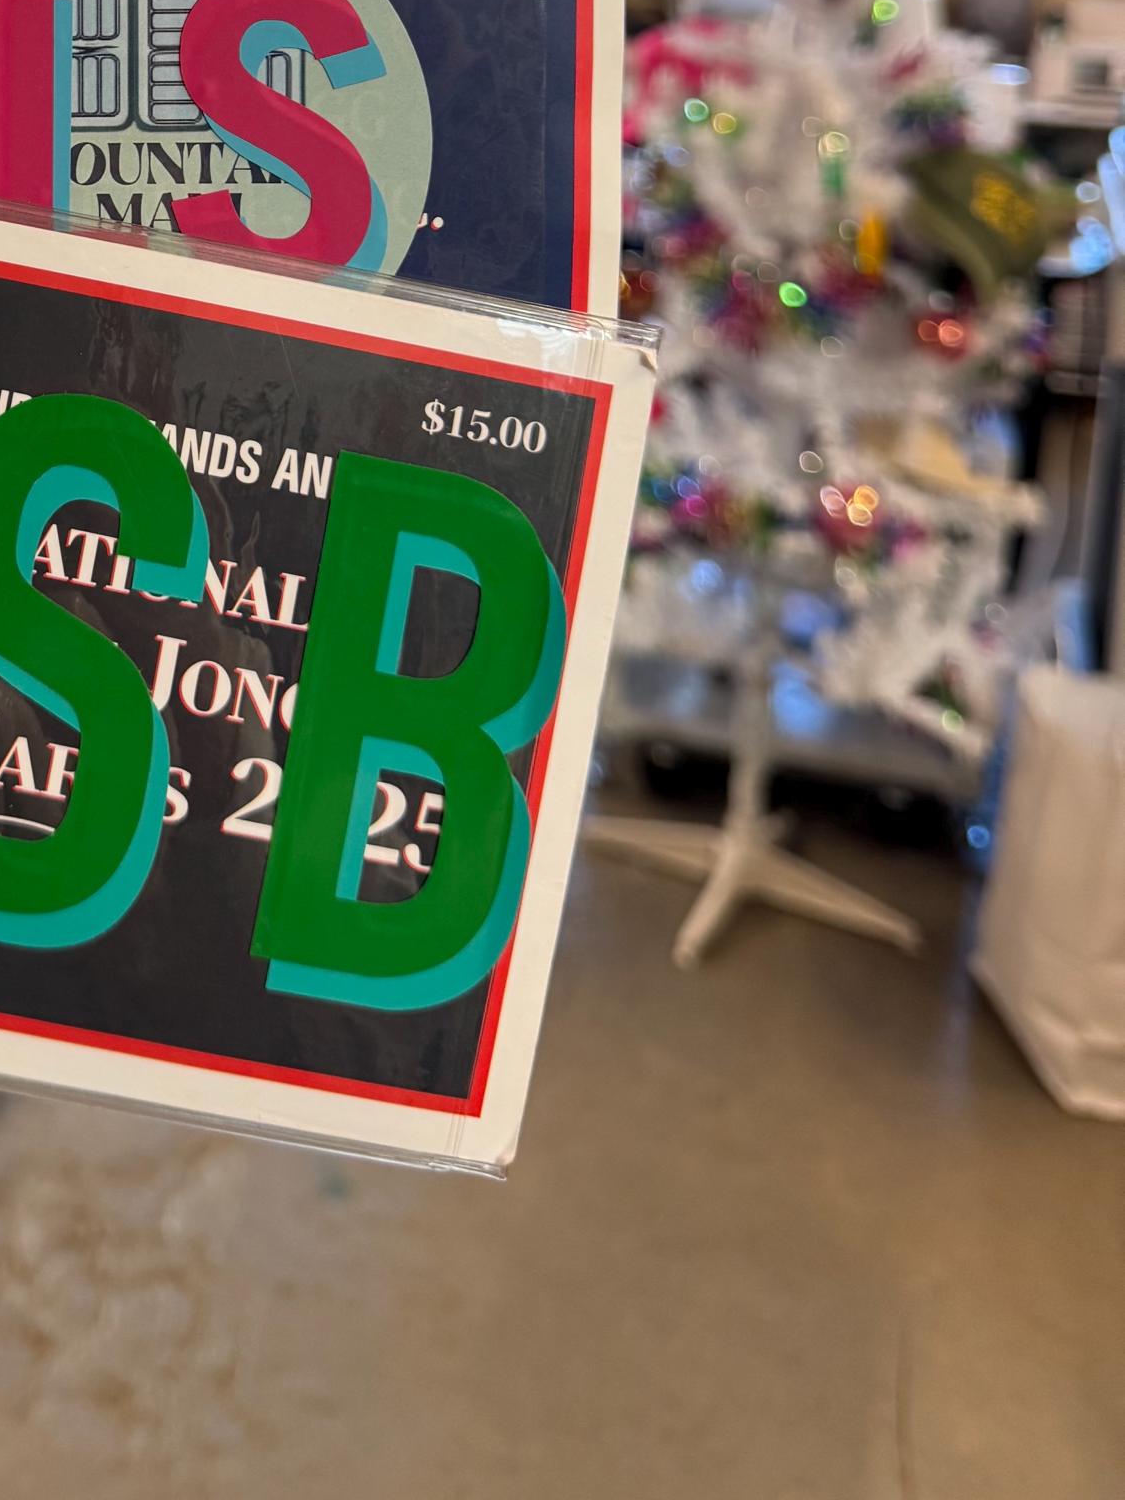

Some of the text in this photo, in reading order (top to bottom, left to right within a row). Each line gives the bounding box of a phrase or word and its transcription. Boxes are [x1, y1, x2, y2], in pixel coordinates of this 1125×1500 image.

[70, 141, 287, 186] OUNTA
[147, 418, 261, 484] ANDS
[272, 447, 332, 499] AN
[421, 399, 547, 454] $15.00
[30, 522, 310, 633] ATINAL
[151, 634, 299, 732] JON
[219, 757, 444, 874] 225
